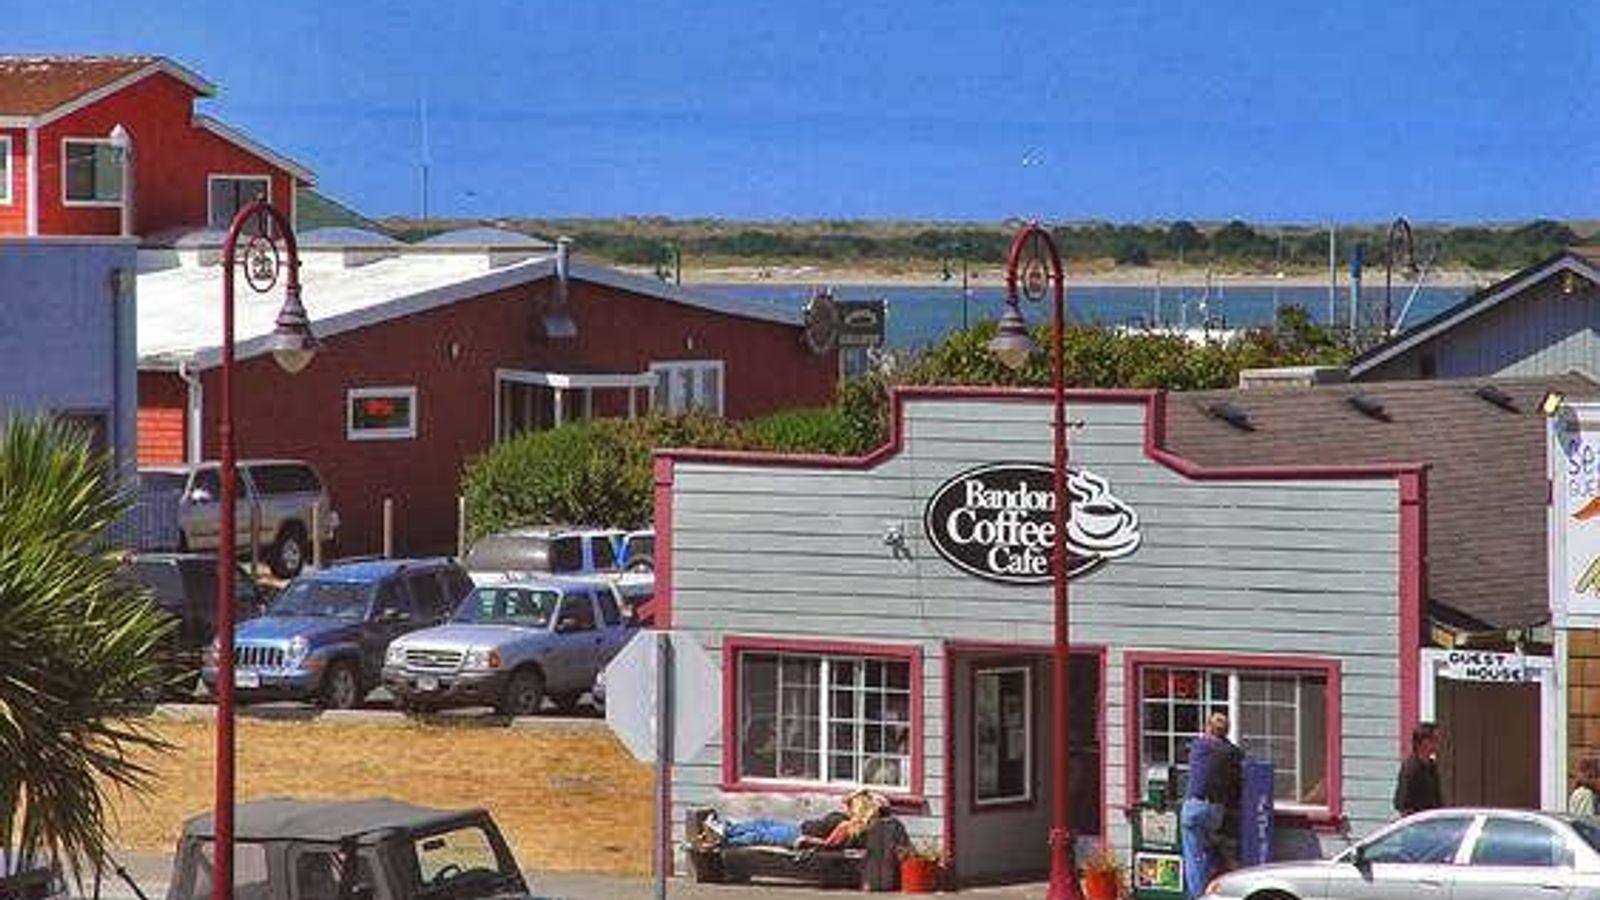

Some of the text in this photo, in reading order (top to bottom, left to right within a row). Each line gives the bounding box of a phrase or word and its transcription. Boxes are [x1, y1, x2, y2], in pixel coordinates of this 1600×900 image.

[965, 480, 1056, 511] Bandon
[947, 507, 1056, 547] Coffee
[1449, 652, 1506, 666] GUEST
[1466, 667, 1523, 680] HOUSE
